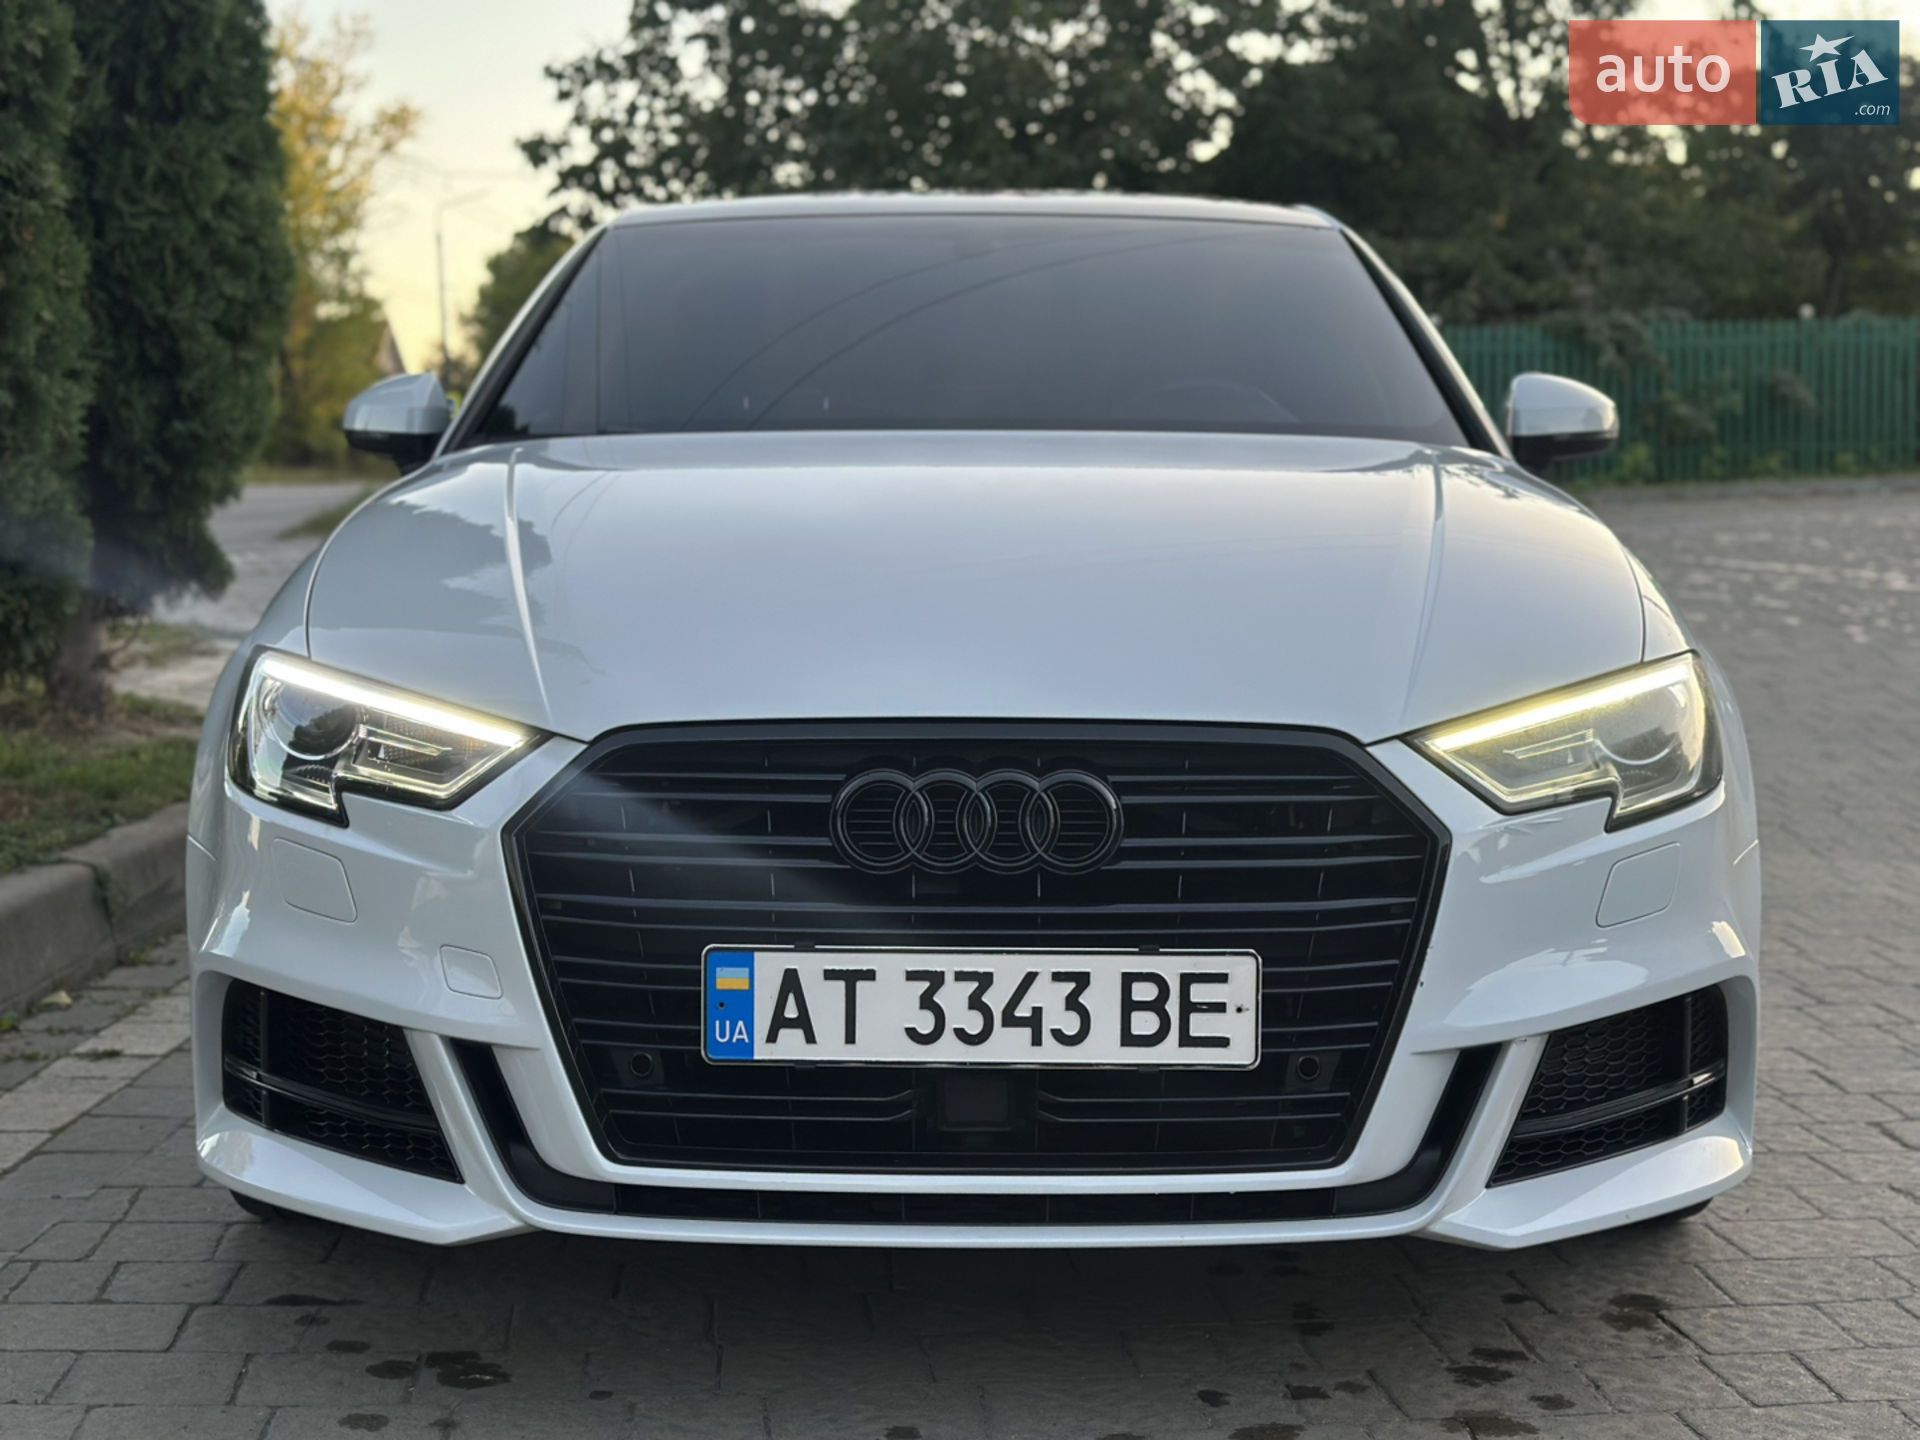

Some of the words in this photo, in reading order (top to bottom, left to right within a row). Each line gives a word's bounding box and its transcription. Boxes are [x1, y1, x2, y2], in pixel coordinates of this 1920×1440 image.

[714, 1019, 750, 1043] UA
[765, 968, 877, 1045] AT
[904, 969, 1092, 1047] 3343
[1119, 971, 1231, 1048] BE
